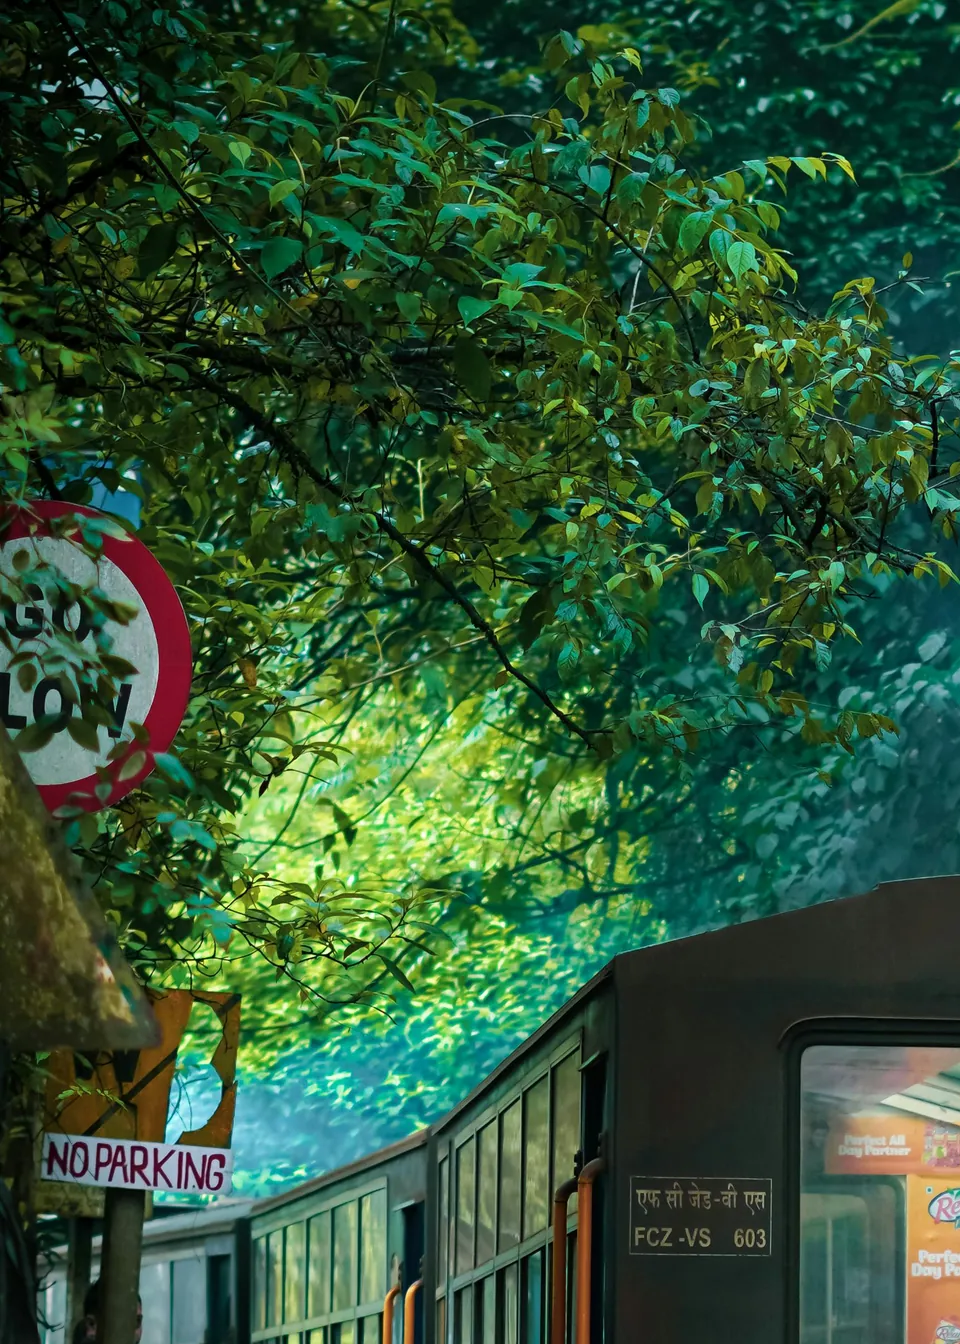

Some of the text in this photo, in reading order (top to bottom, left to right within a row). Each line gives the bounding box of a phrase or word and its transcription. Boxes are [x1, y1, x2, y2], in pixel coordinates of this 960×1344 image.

[4, 583, 93, 643] GO
[844, 1134, 906, 1146] Perfect All
[838, 1144, 912, 1158] Day Partner
[47, 1141, 226, 1190] NO PARKING
[636, 1189, 660, 1214] एफ
[665, 1182, 684, 1209] सी
[744, 1191, 766, 1216] एस
[734, 1228, 766, 1248] 603
[912, 1262, 942, 1280] Day
